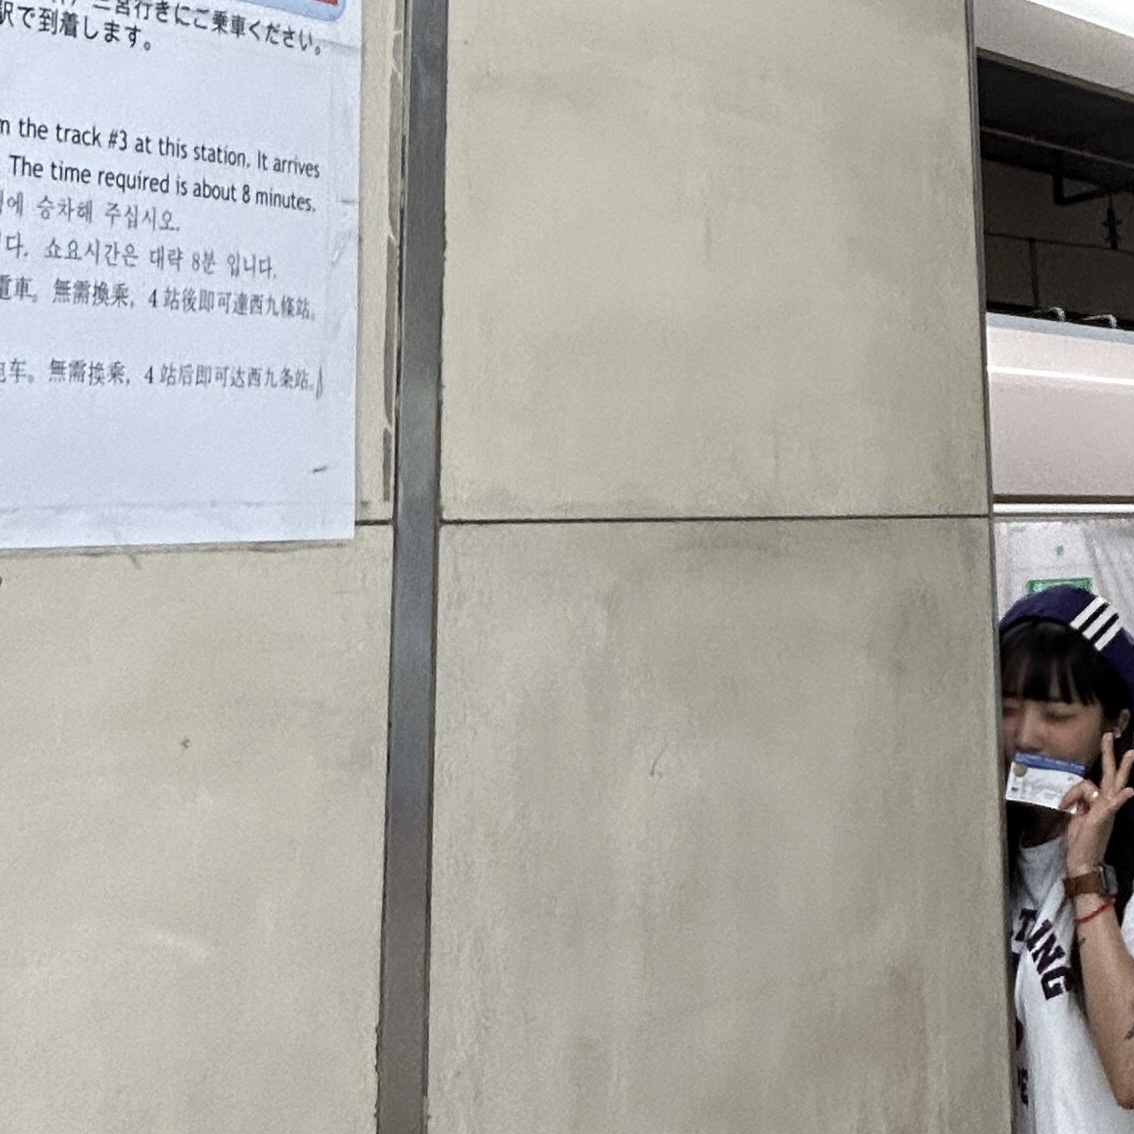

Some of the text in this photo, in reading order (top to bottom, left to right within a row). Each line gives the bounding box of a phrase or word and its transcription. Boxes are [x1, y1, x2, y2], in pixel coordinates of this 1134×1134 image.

[19, 117, 48, 140] the
[56, 124, 102, 148] track
[108, 129, 128, 151] #3
[134, 136, 152, 155] at
[159, 137, 187, 160] this
[193, 143, 251, 169] station.
[257, 150, 269, 171] It
[273, 154, 320, 179] arrives
[9, 154, 316, 213] The time required is about 8 minutes.
[104, 201, 181, 233] 주십시오.
